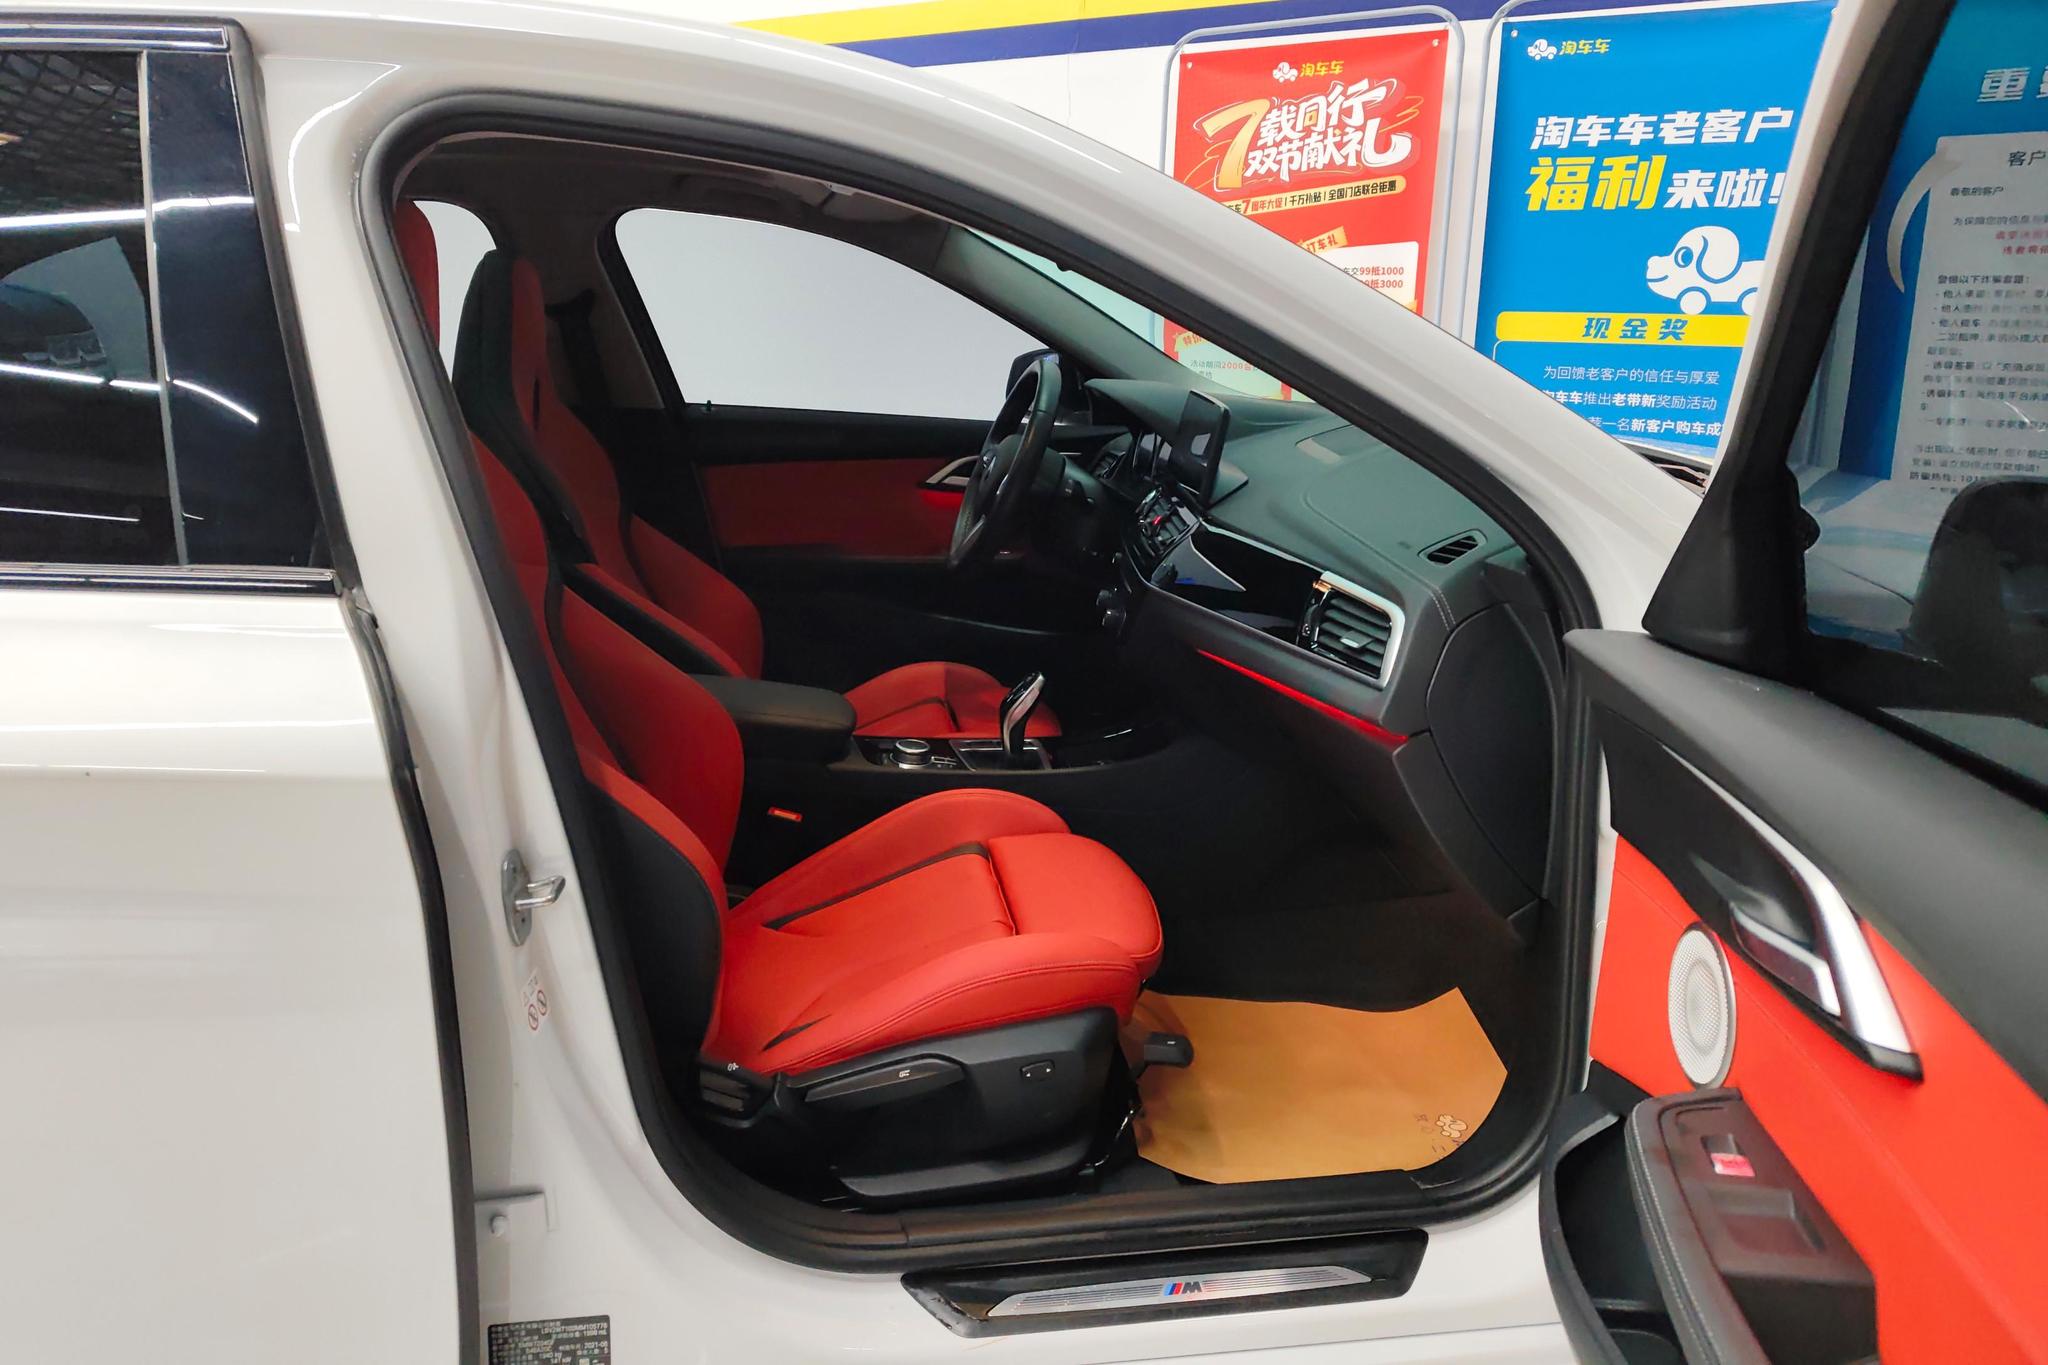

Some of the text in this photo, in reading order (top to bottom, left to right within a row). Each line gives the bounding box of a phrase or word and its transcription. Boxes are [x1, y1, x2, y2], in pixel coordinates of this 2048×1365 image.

[1559, 38, 1611, 56] 淘车车
[1299, 60, 1344, 78] 淘车车
[1977, 66, 2048, 102] 重
[1529, 106, 1794, 150] 淘车车老客户
[2007, 150, 2046, 168] 客户
[1582, 317, 1689, 341] 现金奖
[1543, 366, 1720, 386] 为回馈老客户的信任与厚爱
[1588, 417, 1724, 437] 荐一名新客户购车成
